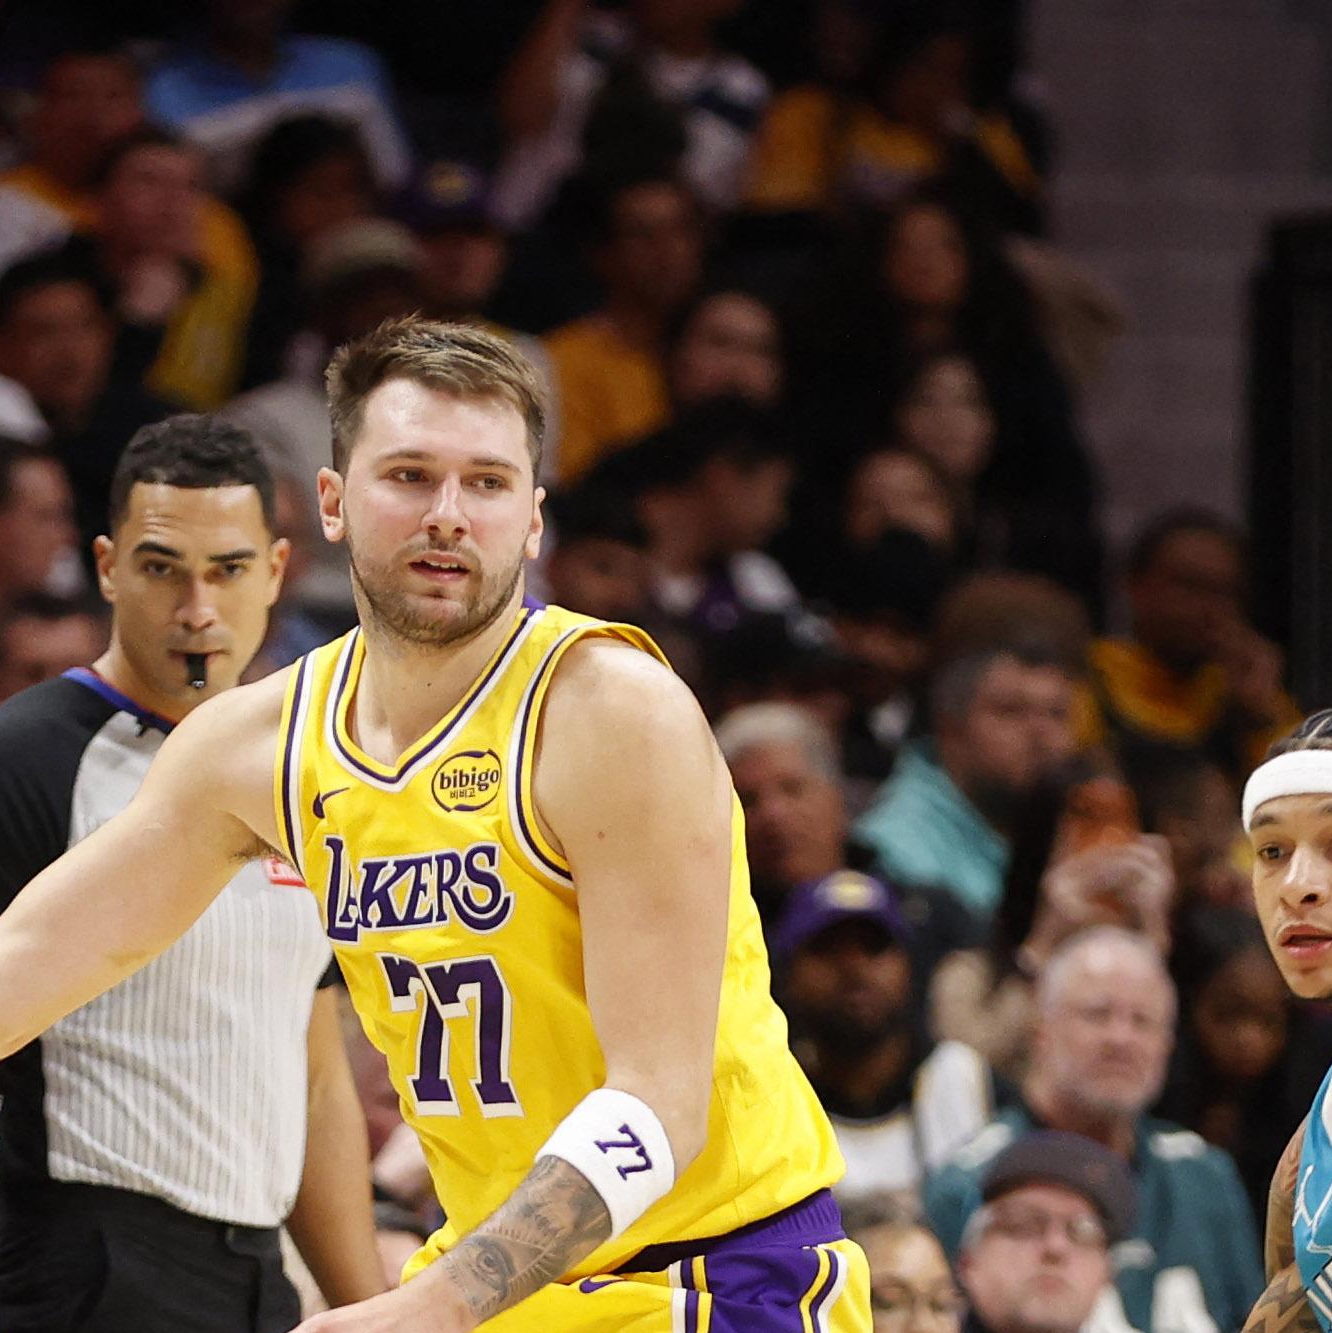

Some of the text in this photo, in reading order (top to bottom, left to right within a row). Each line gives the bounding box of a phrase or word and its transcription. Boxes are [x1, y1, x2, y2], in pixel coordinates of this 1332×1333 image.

[439, 766, 499, 792] bibigo
[322, 834, 515, 945] LAKERS
[379, 951, 525, 1119] 77
[594, 1123, 653, 1182] 77
